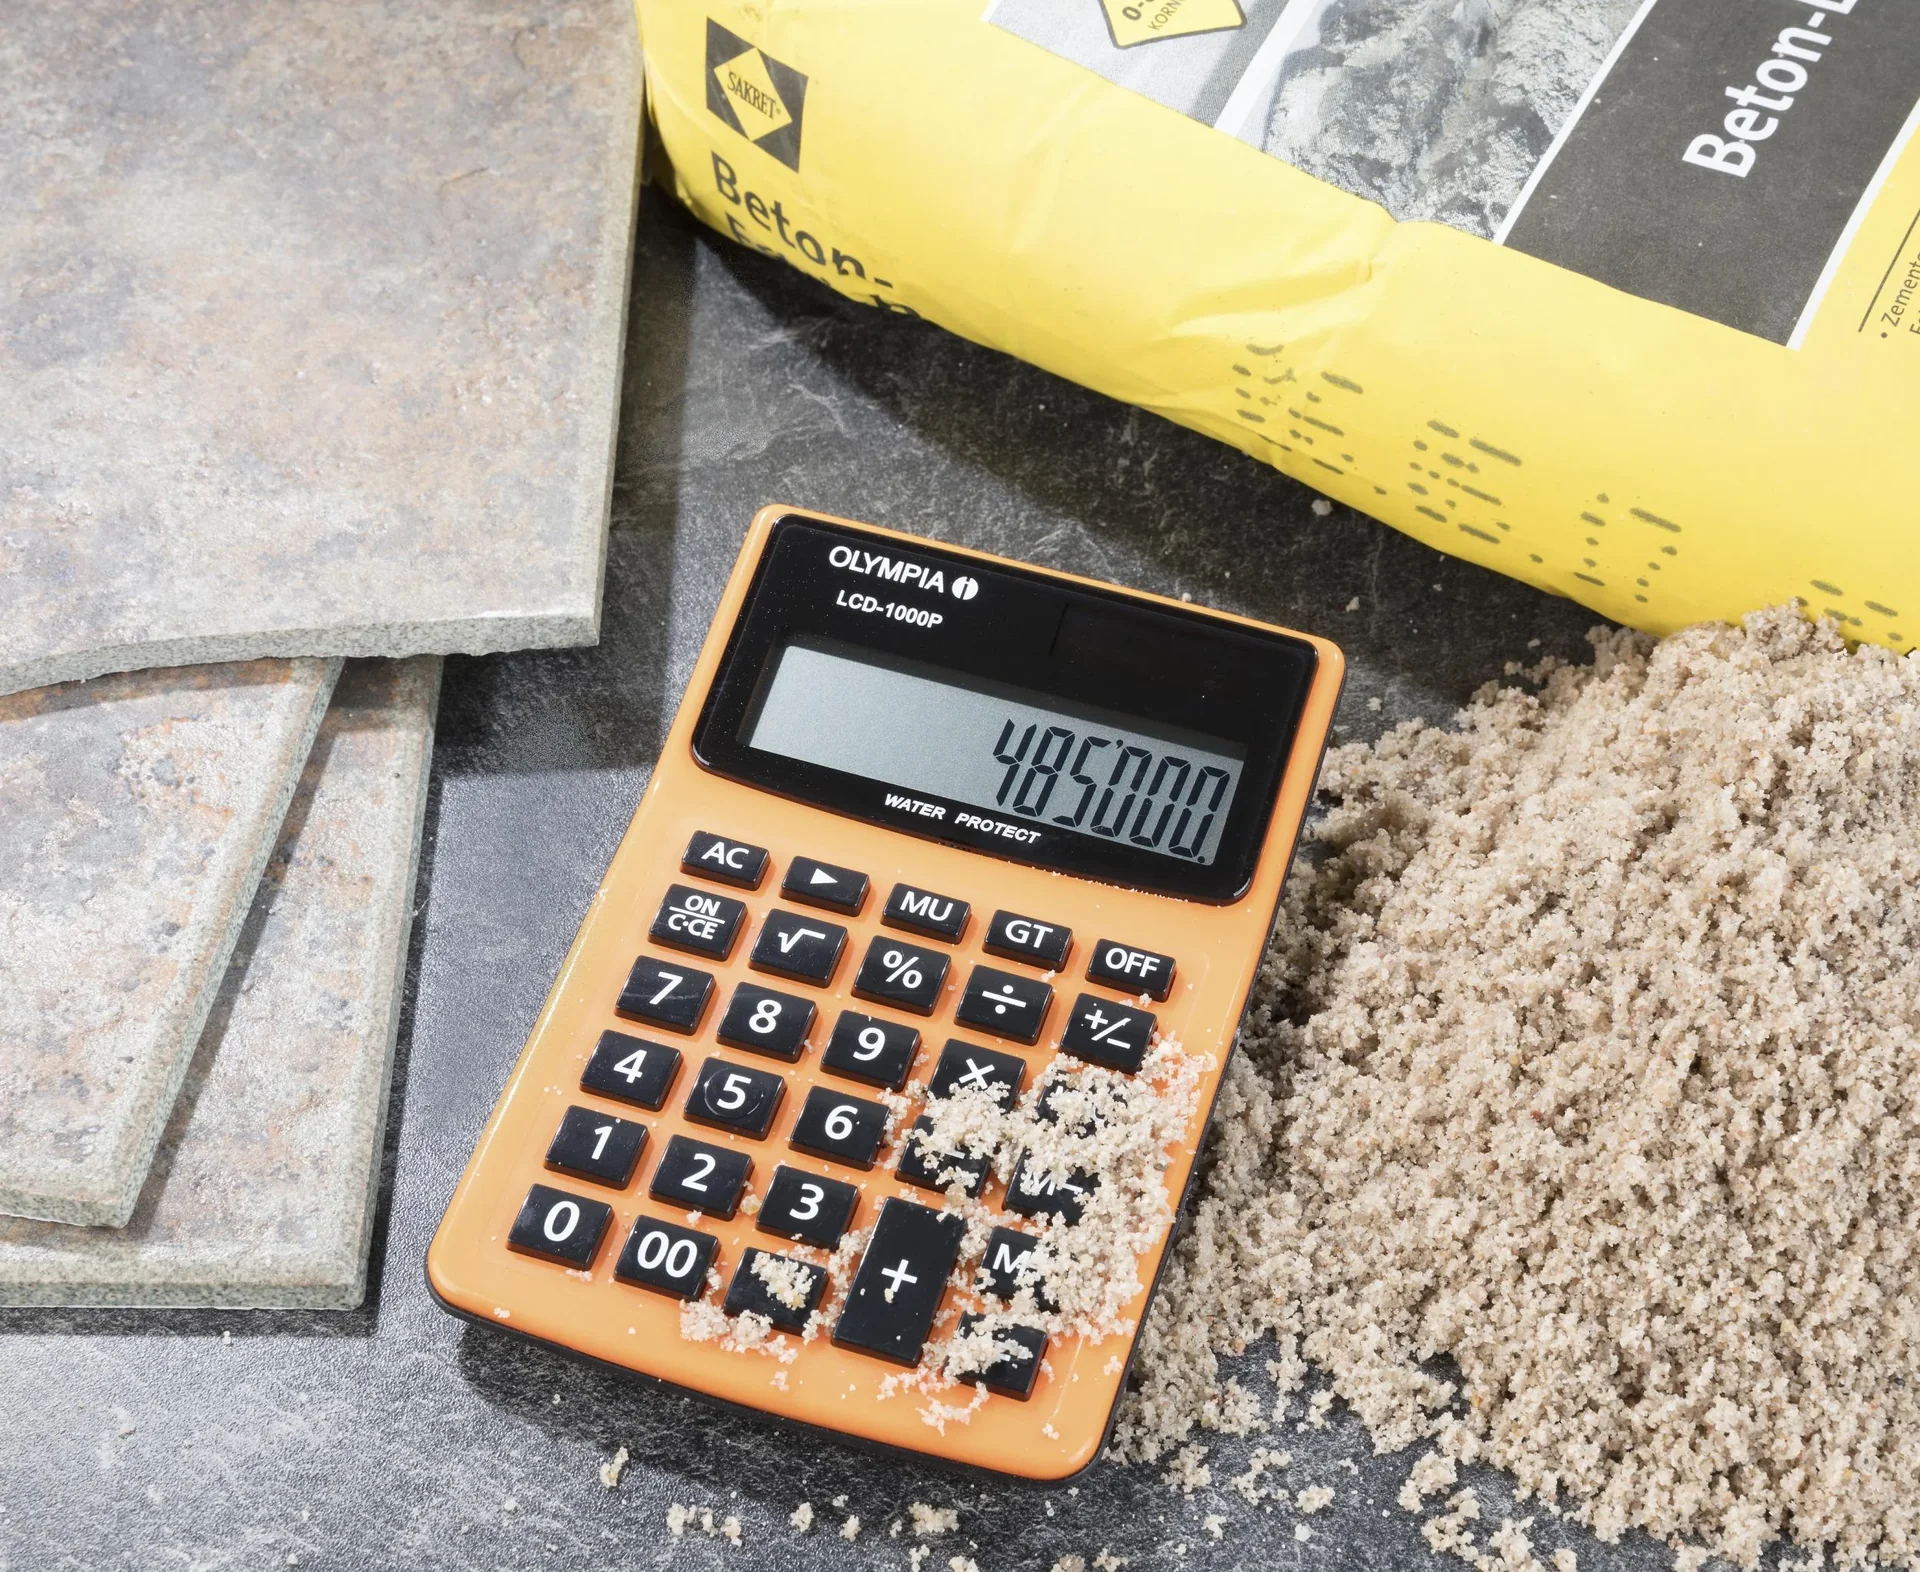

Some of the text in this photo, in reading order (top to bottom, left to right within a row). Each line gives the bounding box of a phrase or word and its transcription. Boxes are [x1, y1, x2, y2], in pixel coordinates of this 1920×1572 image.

[1122, 0, 1155, 21] 0-
[1147, 0, 1187, 31] KORN
[711, 150, 893, 289] Beton-
[1880, 252, 1920, 328] Zement
[829, 545, 945, 593] OLYMPIA
[836, 589, 944, 628] LCD-1000P
[884, 793, 1042, 845] WATER PROTECT
[701, 841, 750, 870] AC
[684, 895, 721, 917] ON
[899, 890, 954, 921] MU
[1005, 919, 1054, 949] GT
[882, 949, 923, 989] %
[1105, 947, 1161, 978] OFF
[649, 965, 684, 1005] 7
[748, 999, 783, 1034] 8
[852, 1026, 886, 1061] 9
[613, 1048, 648, 1084] 4
[716, 1073, 752, 1110] 5
[824, 1104, 859, 1141] 6
[591, 1125, 620, 1160] 1
[681, 1152, 716, 1193] 2
[788, 1182, 825, 1221] 3
[542, 1200, 581, 1242] 0
[636, 1229, 699, 1278] 00
